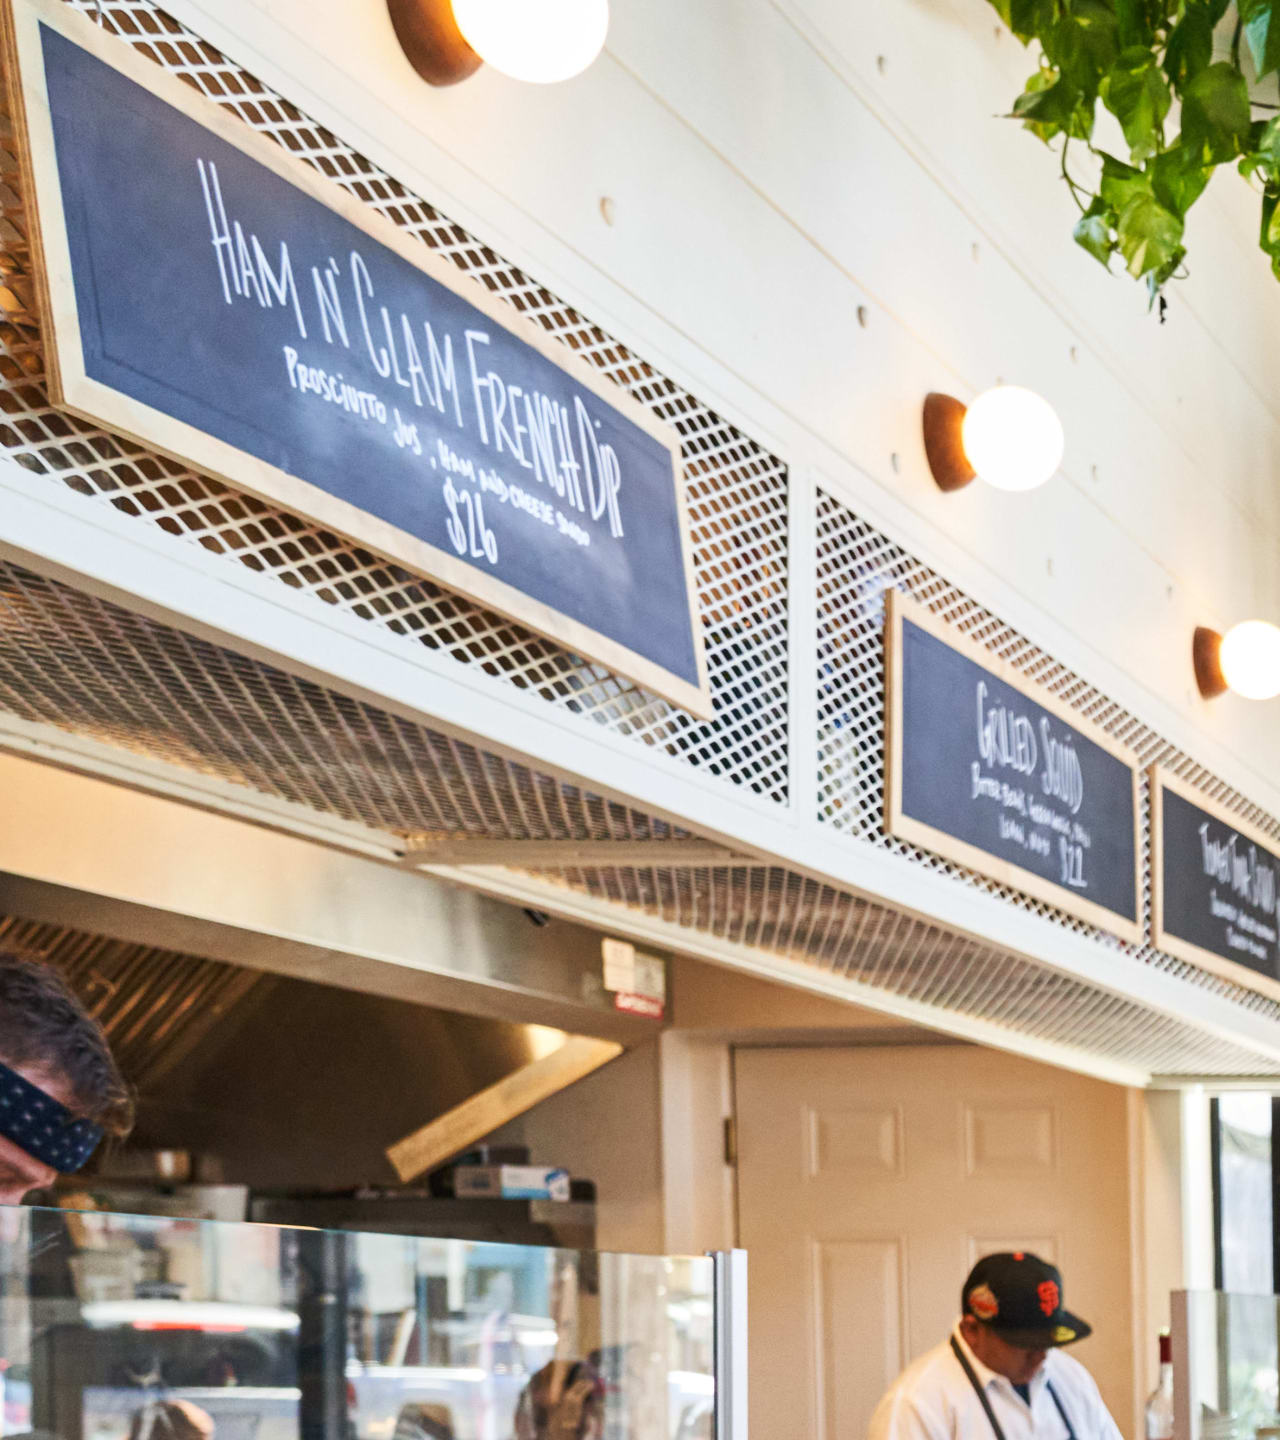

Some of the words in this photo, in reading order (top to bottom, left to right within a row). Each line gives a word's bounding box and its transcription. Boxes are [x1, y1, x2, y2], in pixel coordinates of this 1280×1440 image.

[197, 158, 307, 339] HAM
[351, 250, 463, 428] CLAM
[464, 329, 586, 512] FRENCH
[443, 476, 498, 565] $26
